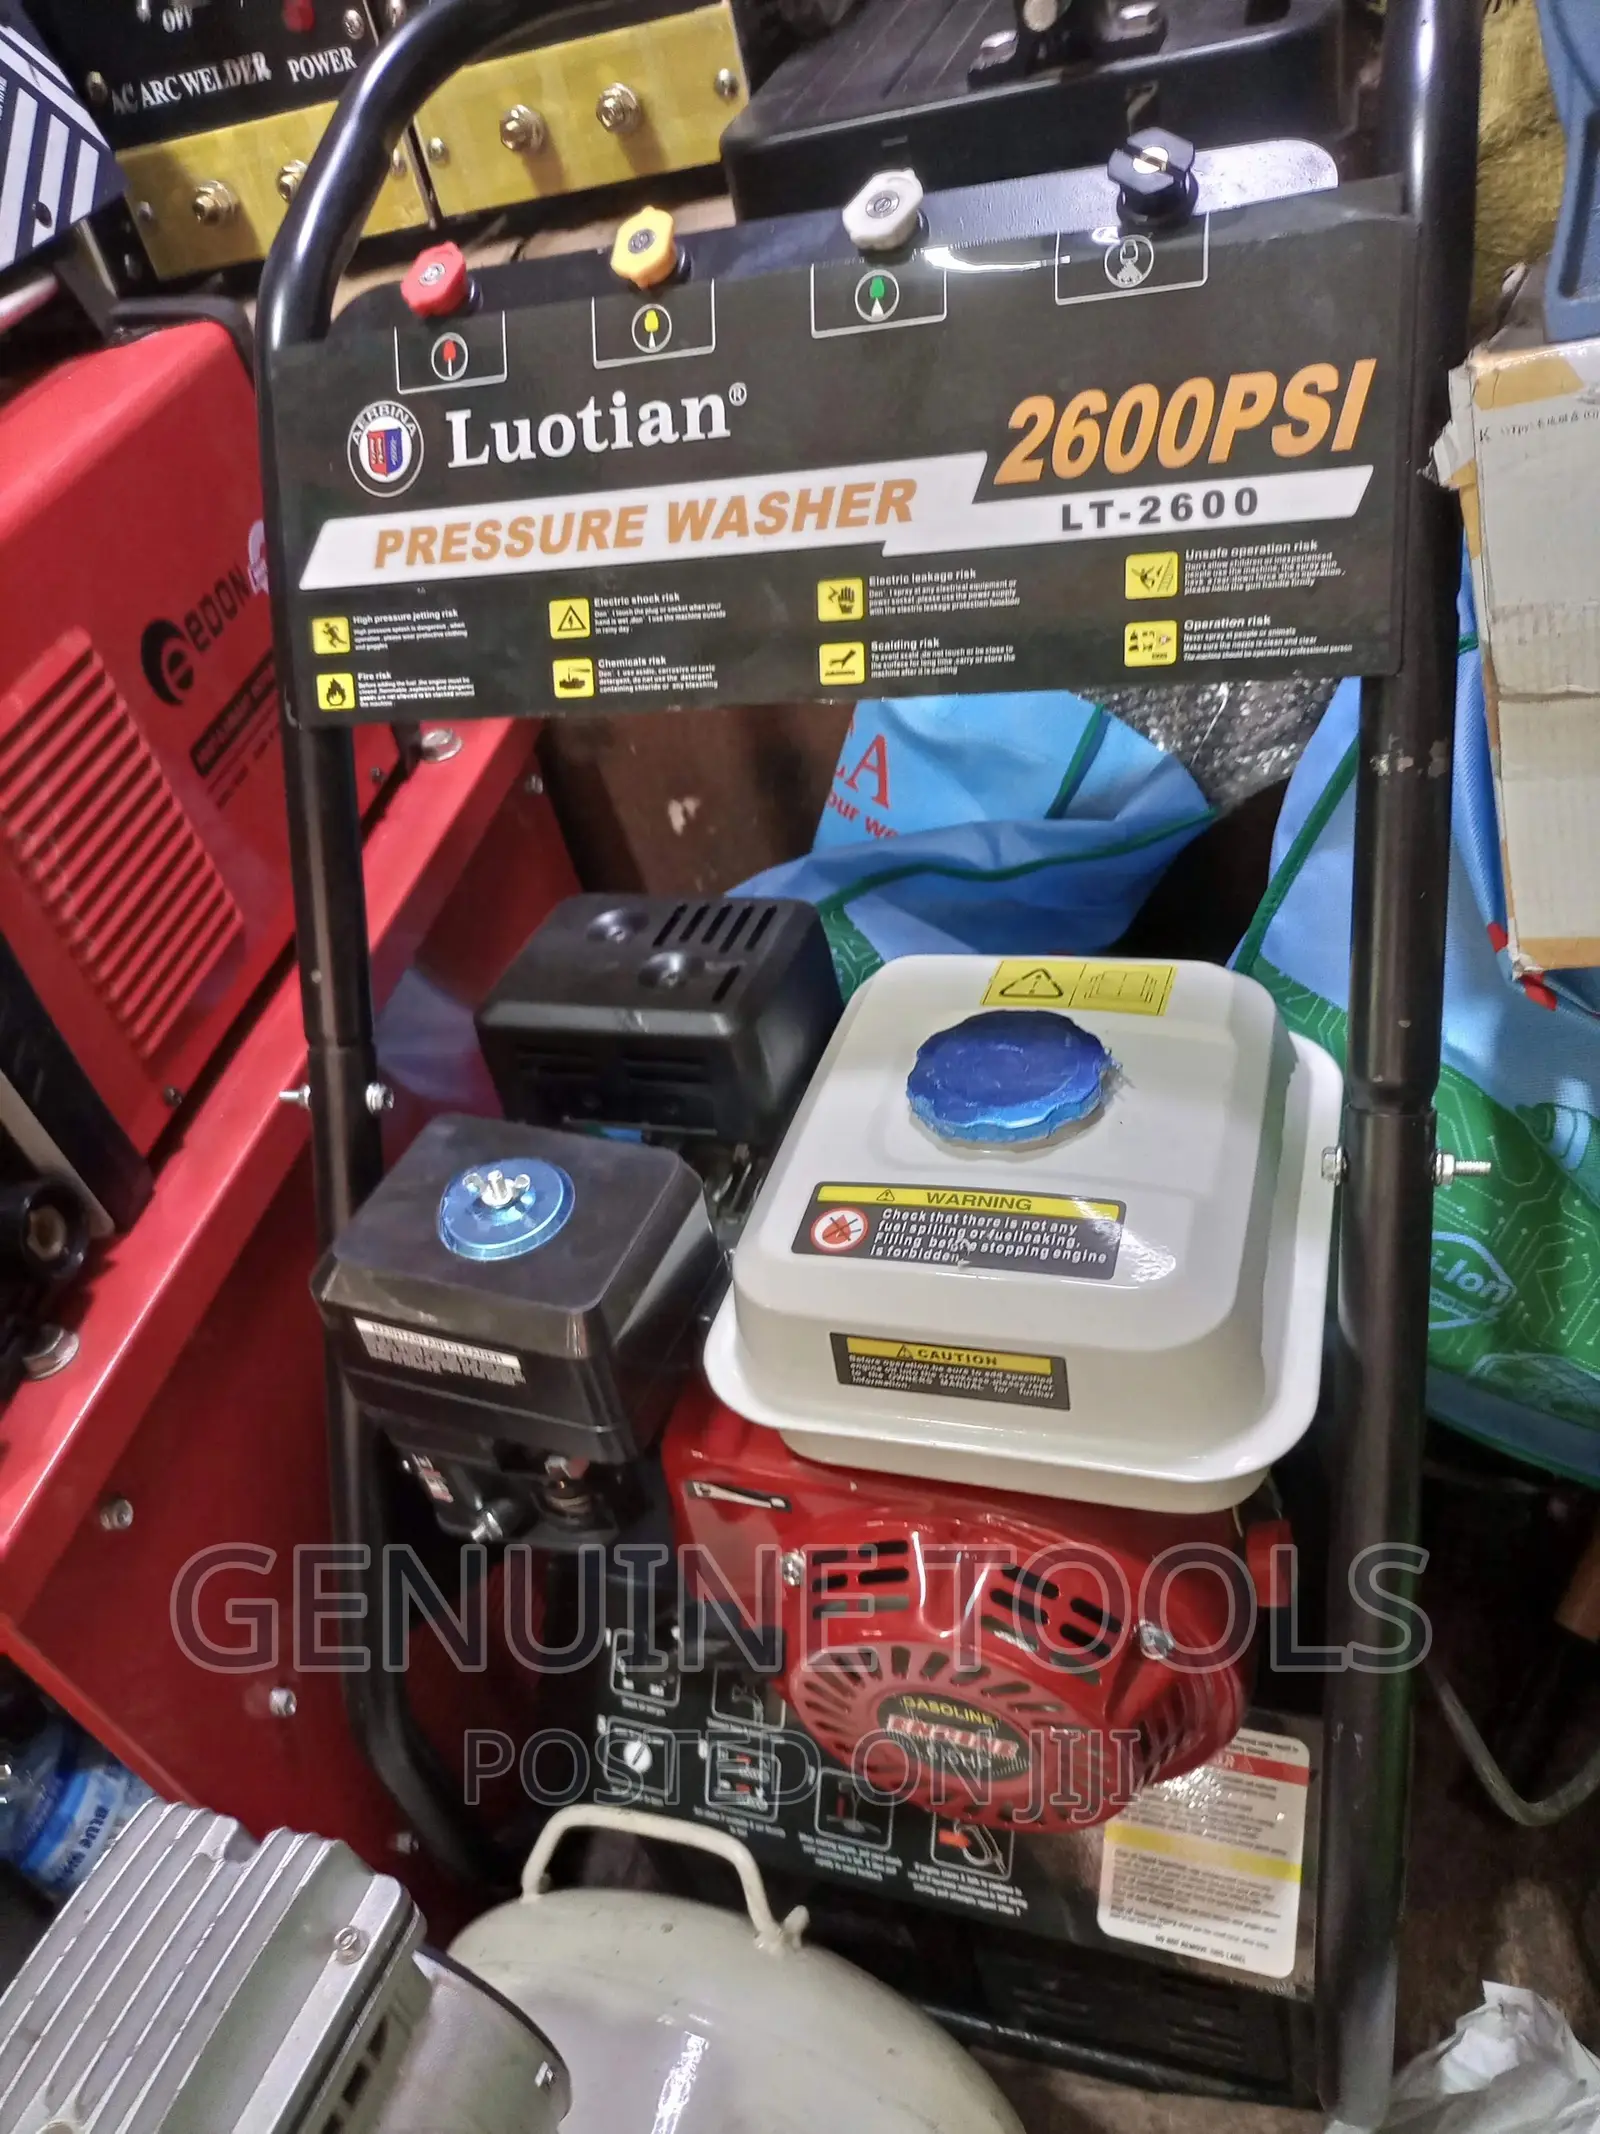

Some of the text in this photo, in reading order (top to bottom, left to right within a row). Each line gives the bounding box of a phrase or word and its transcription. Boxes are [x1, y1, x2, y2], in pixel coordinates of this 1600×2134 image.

[111, 46, 358, 115] AC ARC WELDER POWER
[993, 358, 1378, 485] 2600PSI
[1062, 487, 1258, 532] LT-2600
[374, 478, 918, 569] PRESSURE WASHER
[1185, 539, 1319, 561] Unsafe operation risk
[869, 568, 976, 587] Electric leakage risk
[1184, 614, 1271, 632] Operation risk
[926, 1191, 1032, 1212] WARNING
[878, 1219, 905, 1233] fuel
[909, 1221, 966, 1240] spilling
[882, 1208, 1078, 1236] Check that there is not any
[870, 1244, 883, 1257] is
[874, 1232, 921, 1247] Filling
[979, 1242, 1048, 1260] stopping
[1052, 1249, 1107, 1265] engine
[917, 1349, 997, 1365] CAUTION
